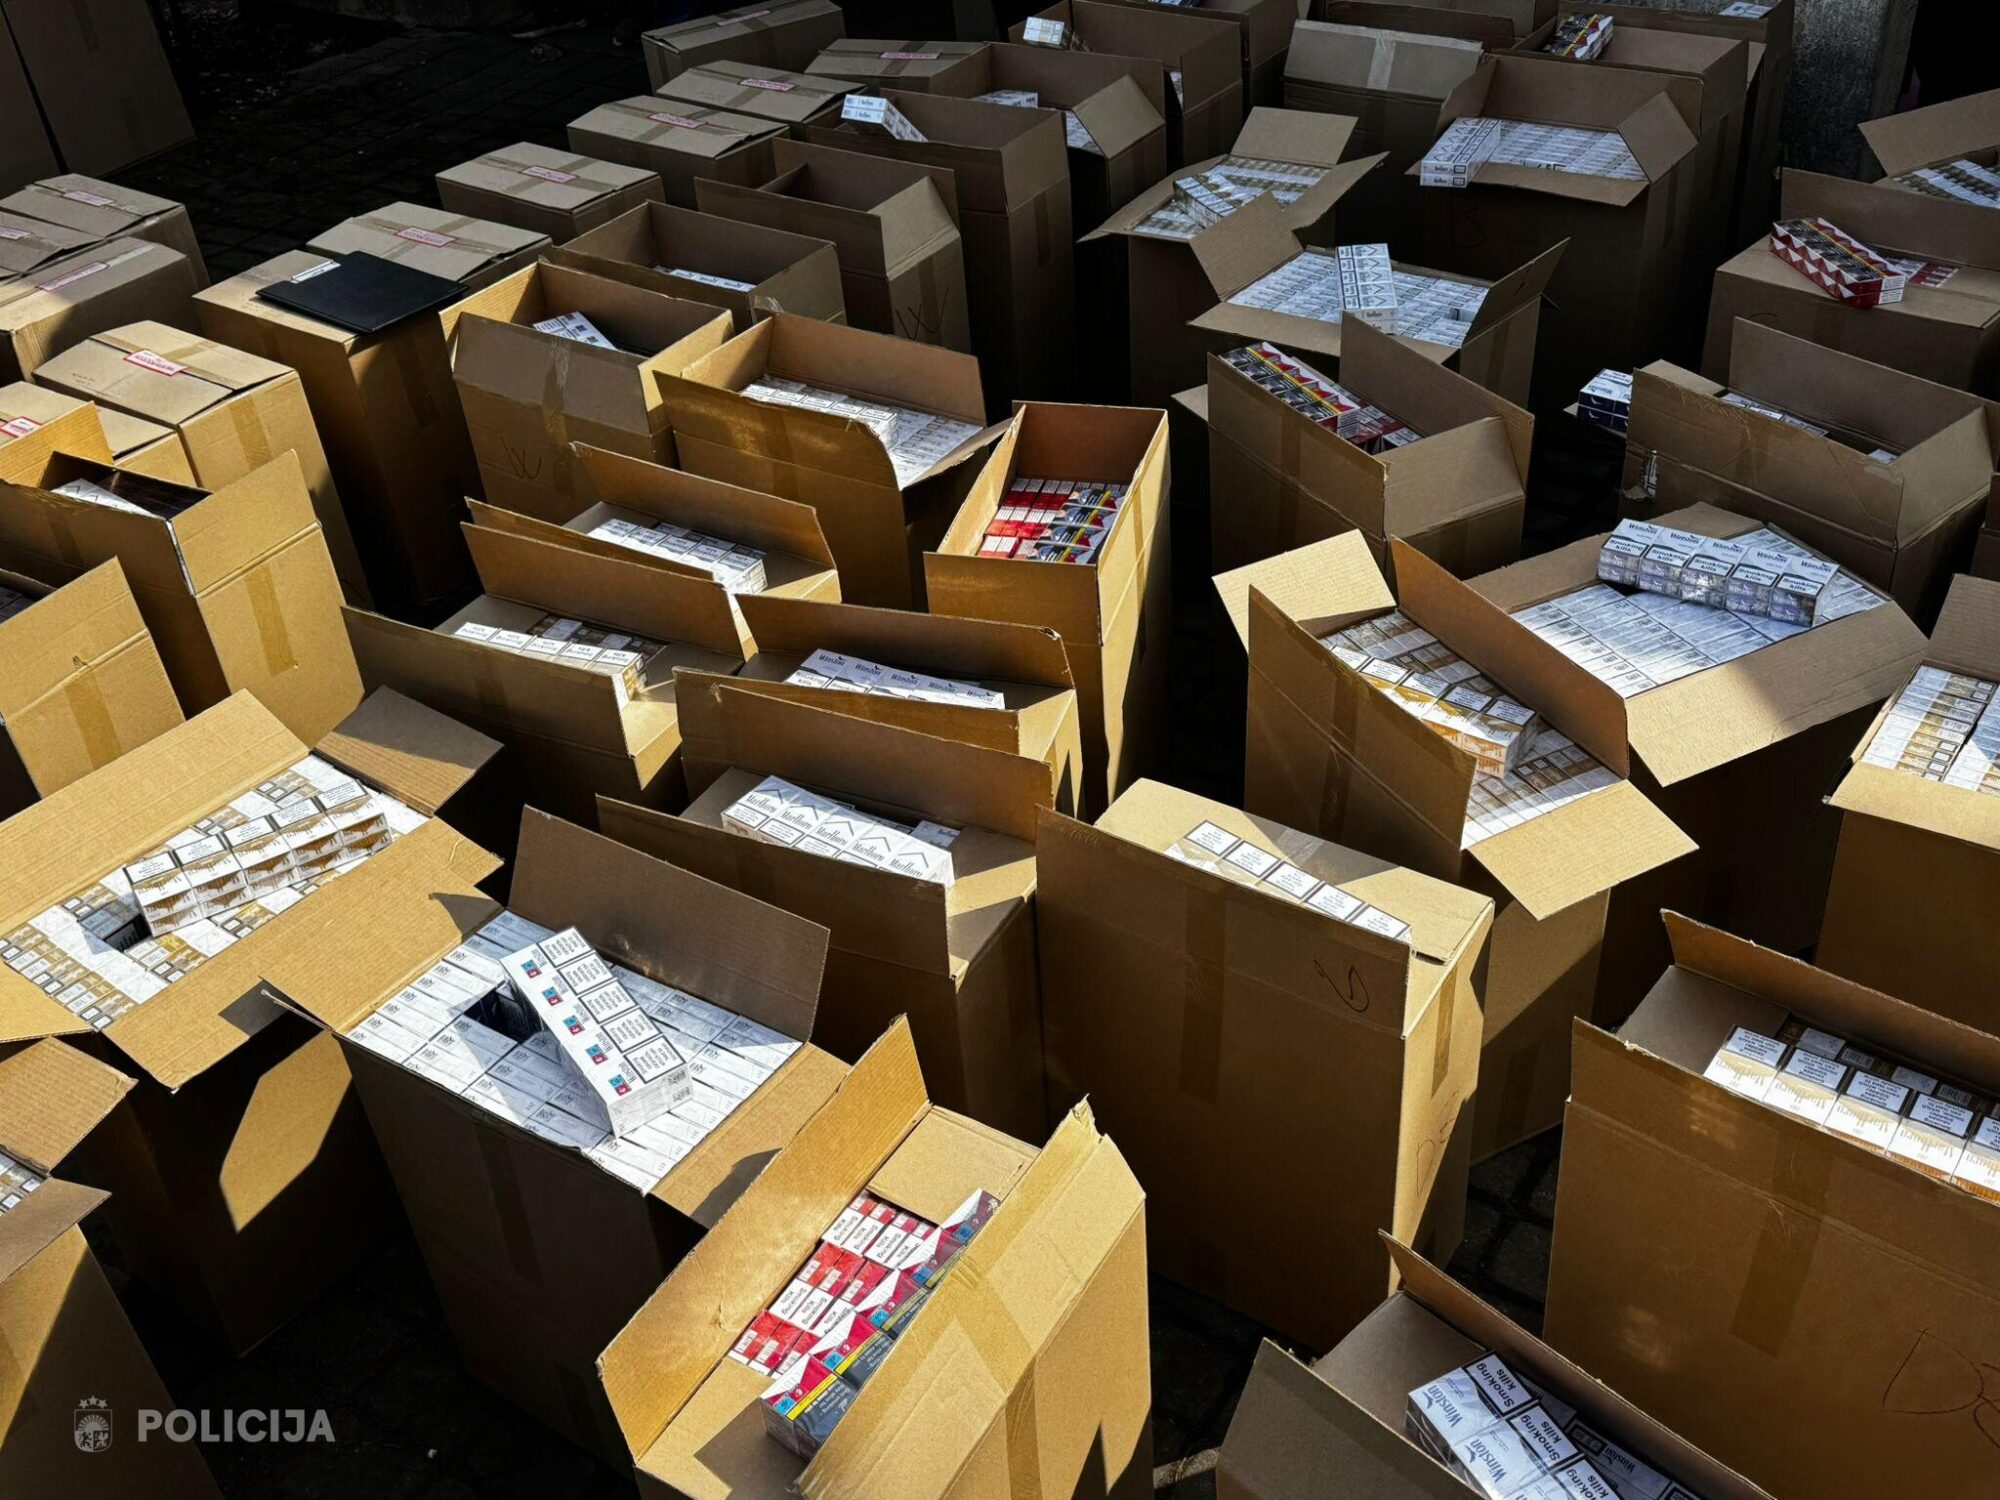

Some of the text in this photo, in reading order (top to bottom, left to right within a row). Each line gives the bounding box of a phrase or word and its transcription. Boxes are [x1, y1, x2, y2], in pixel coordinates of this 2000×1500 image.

[1629, 523, 1657, 535] Winston
[1610, 538, 1644, 551] Smoking
[1670, 532, 1700, 545] Winston
[1712, 541, 1742, 553] Winston
[1651, 548, 1686, 562] Smoking
[1657, 554, 1674, 563] kills
[1756, 551, 1787, 563] Winston
[1694, 558, 1730, 571] Smoking
[1700, 564, 1717, 573] kills
[1800, 559, 1832, 574] Winston
[1738, 568, 1774, 581] Smoking
[1745, 574, 1762, 583] kills
[1783, 578, 1819, 592] Smoking
[1790, 583, 1807, 592] kills
[819, 654, 846, 666] Winston
[855, 663, 881, 676] Winston
[892, 673, 918, 685] Winston
[746, 794, 777, 814] Marlboro
[782, 810, 813, 829] Marlboro
[816, 827, 848, 846] Marlboro
[853, 842, 885, 862] Marlboro
[889, 858, 923, 877] Marlboro
[1476, 1362, 1515, 1408] Smoking
[1496, 1368, 1517, 1392] kills
[1427, 1384, 1464, 1428] Winston
[1519, 1413, 1560, 1462] Smoking
[1541, 1420, 1562, 1444] kills
[1470, 1438, 1507, 1484] Winston
[1603, 1446, 1635, 1474] Winston
